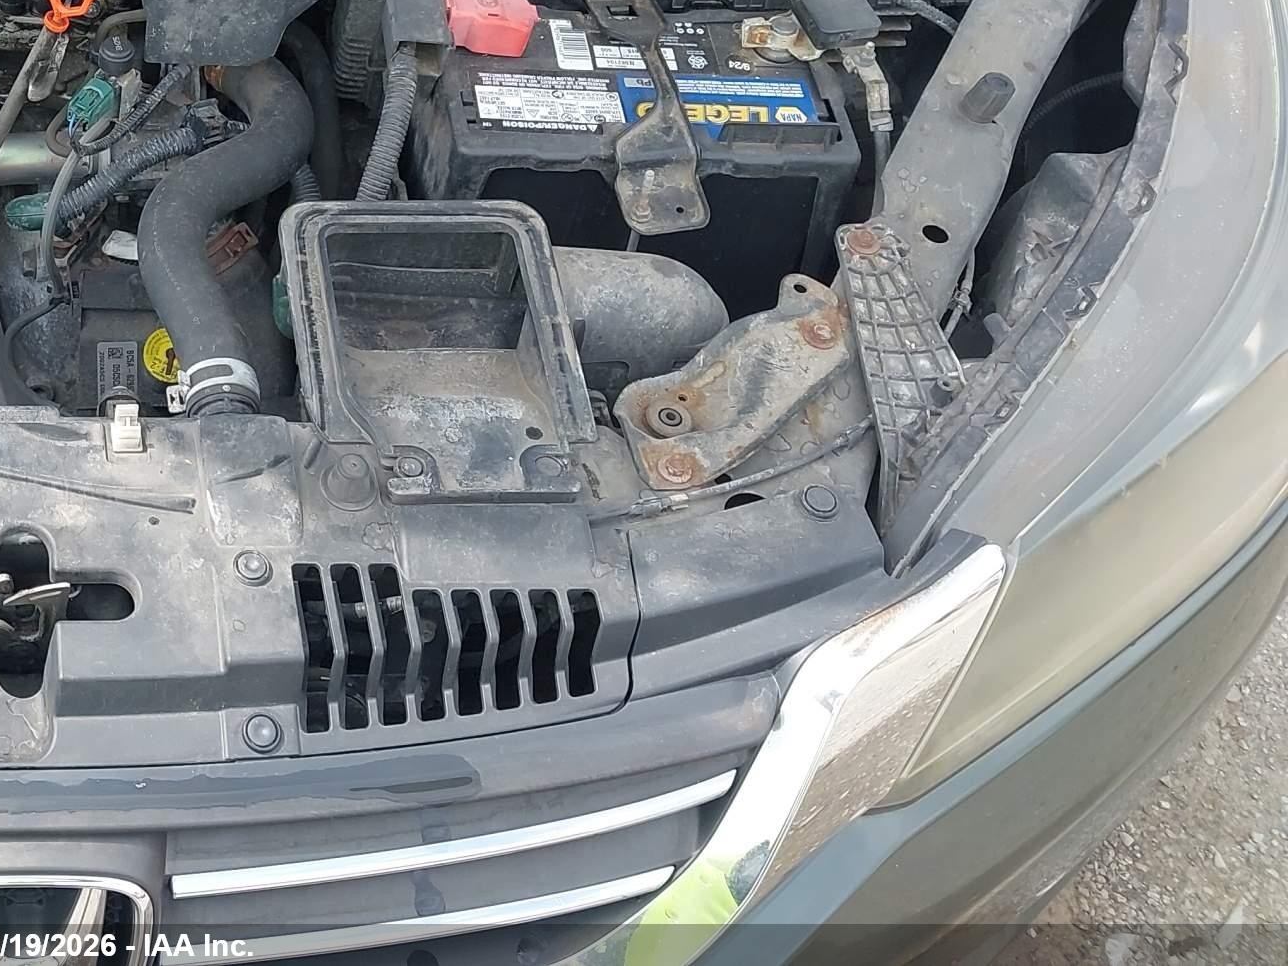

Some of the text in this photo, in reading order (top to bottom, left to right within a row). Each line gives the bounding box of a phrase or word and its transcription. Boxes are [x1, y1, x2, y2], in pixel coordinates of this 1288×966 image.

[728, 59, 752, 71] 9/24
[636, 78, 653, 88] Pb
[636, 101, 804, 124] NAPA LEGED
